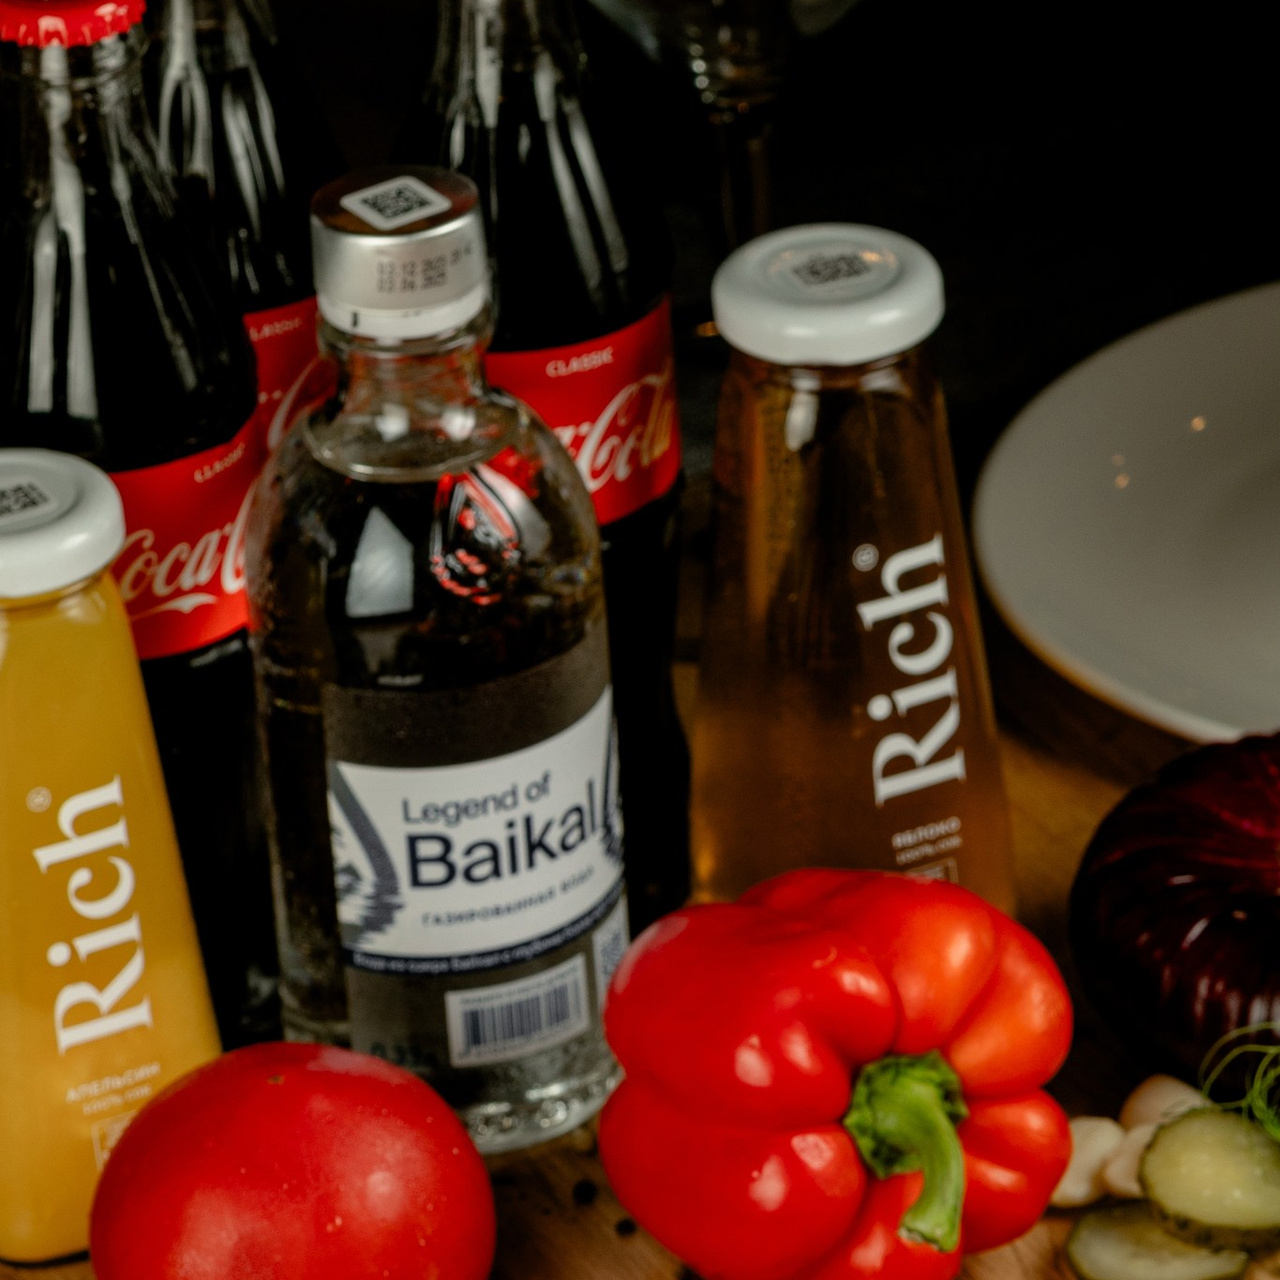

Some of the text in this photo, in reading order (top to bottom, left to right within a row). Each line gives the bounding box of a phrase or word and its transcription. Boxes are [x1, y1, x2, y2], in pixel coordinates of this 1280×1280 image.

[546, 346, 613, 377] CLASSIC
[856, 531, 966, 808] Rich
[403, 769, 551, 827] Legend of
[406, 777, 596, 890] Baikal
[32, 774, 153, 1056] Rich
[422, 885, 556, 926] ГАЗИРОВАННАЯ
[66, 1062, 161, 1104] АПЕЛЬСИН
